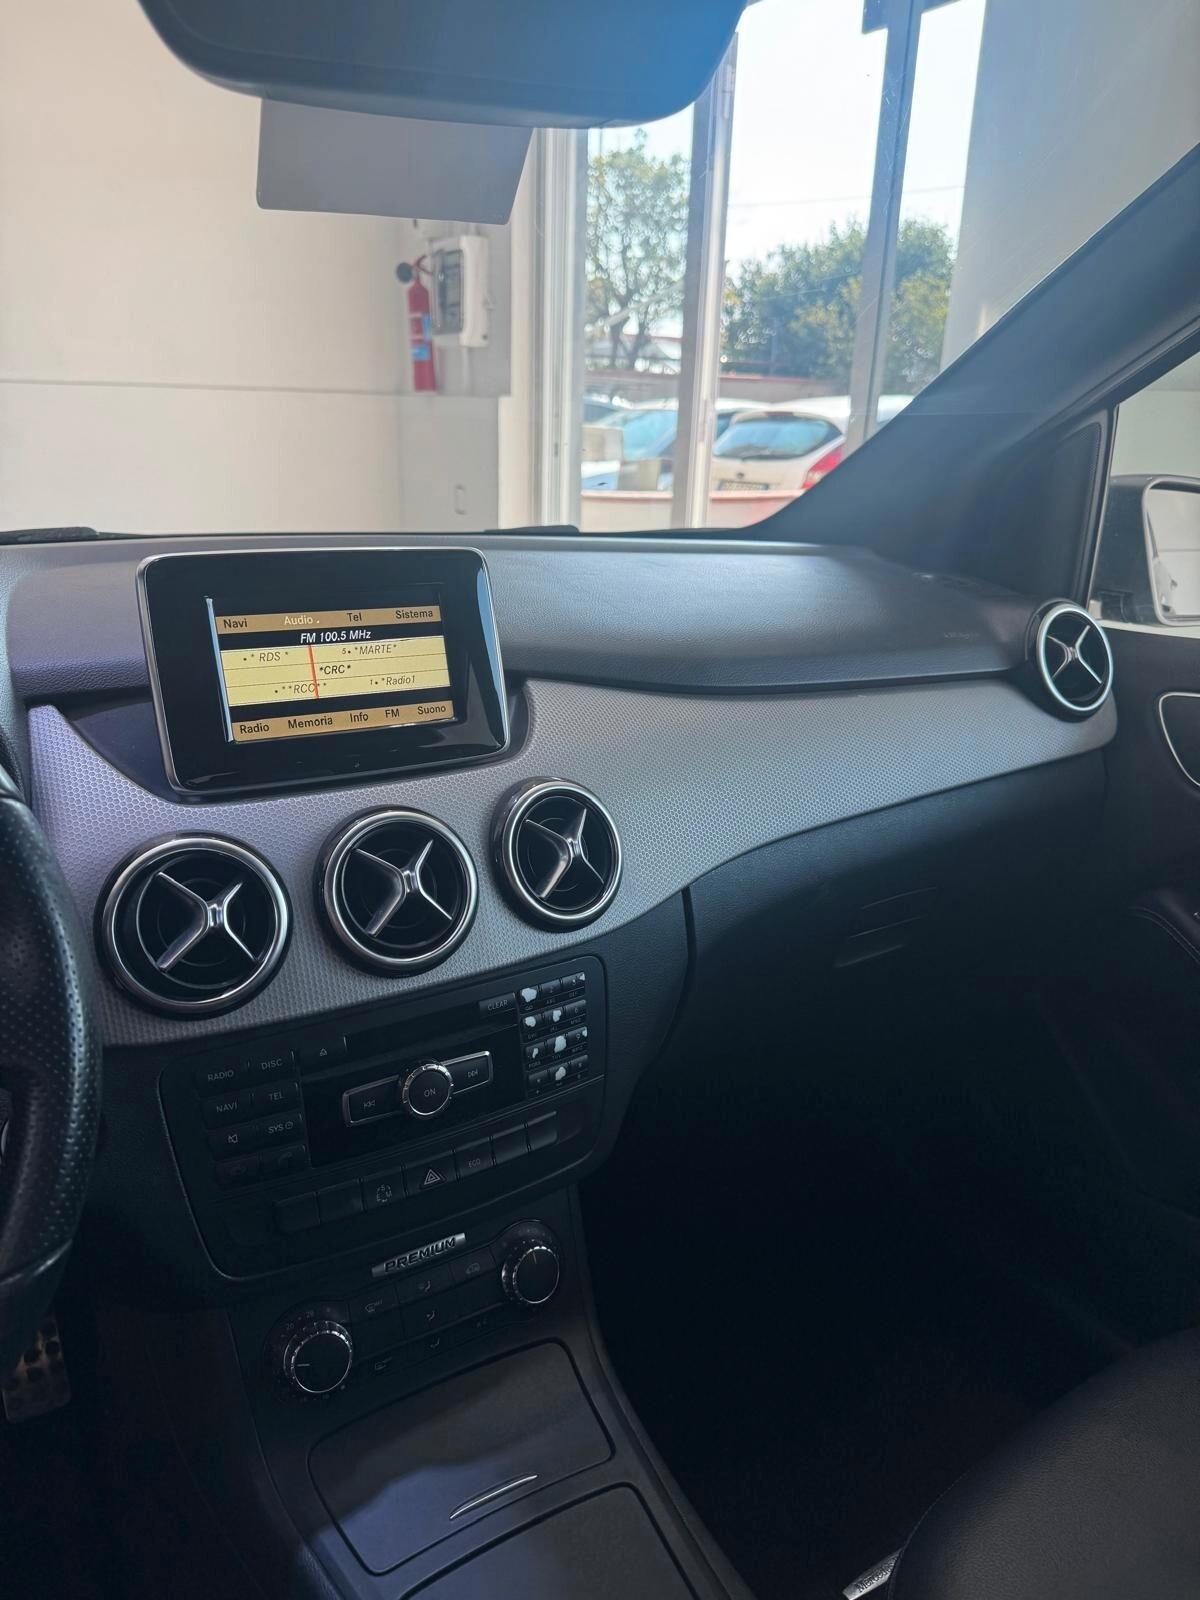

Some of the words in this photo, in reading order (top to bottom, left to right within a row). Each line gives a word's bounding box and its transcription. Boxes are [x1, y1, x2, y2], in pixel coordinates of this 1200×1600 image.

[347, 612, 362, 622] Tel
[395, 609, 434, 620] Sistema
[223, 618, 248, 629] Navi
[283, 615, 314, 626] Audio
[300, 632, 316, 643] FM
[319, 631, 347, 642] 100.5
[349, 630, 372, 641] MHz
[385, 708, 400, 719] FM
[417, 704, 447, 716] Suono
[287, 715, 333, 729] Memoria
[349, 712, 369, 723] Info
[239, 723, 270, 735] Radio
[487, 999, 508, 1011] CLEAR
[261, 1058, 283, 1070] DISC
[207, 1069, 234, 1081] RADIO
[424, 1087, 436, 1098] ON
[216, 1102, 238, 1113] NAVI
[384, 1237, 455, 1273] PREMIUM
